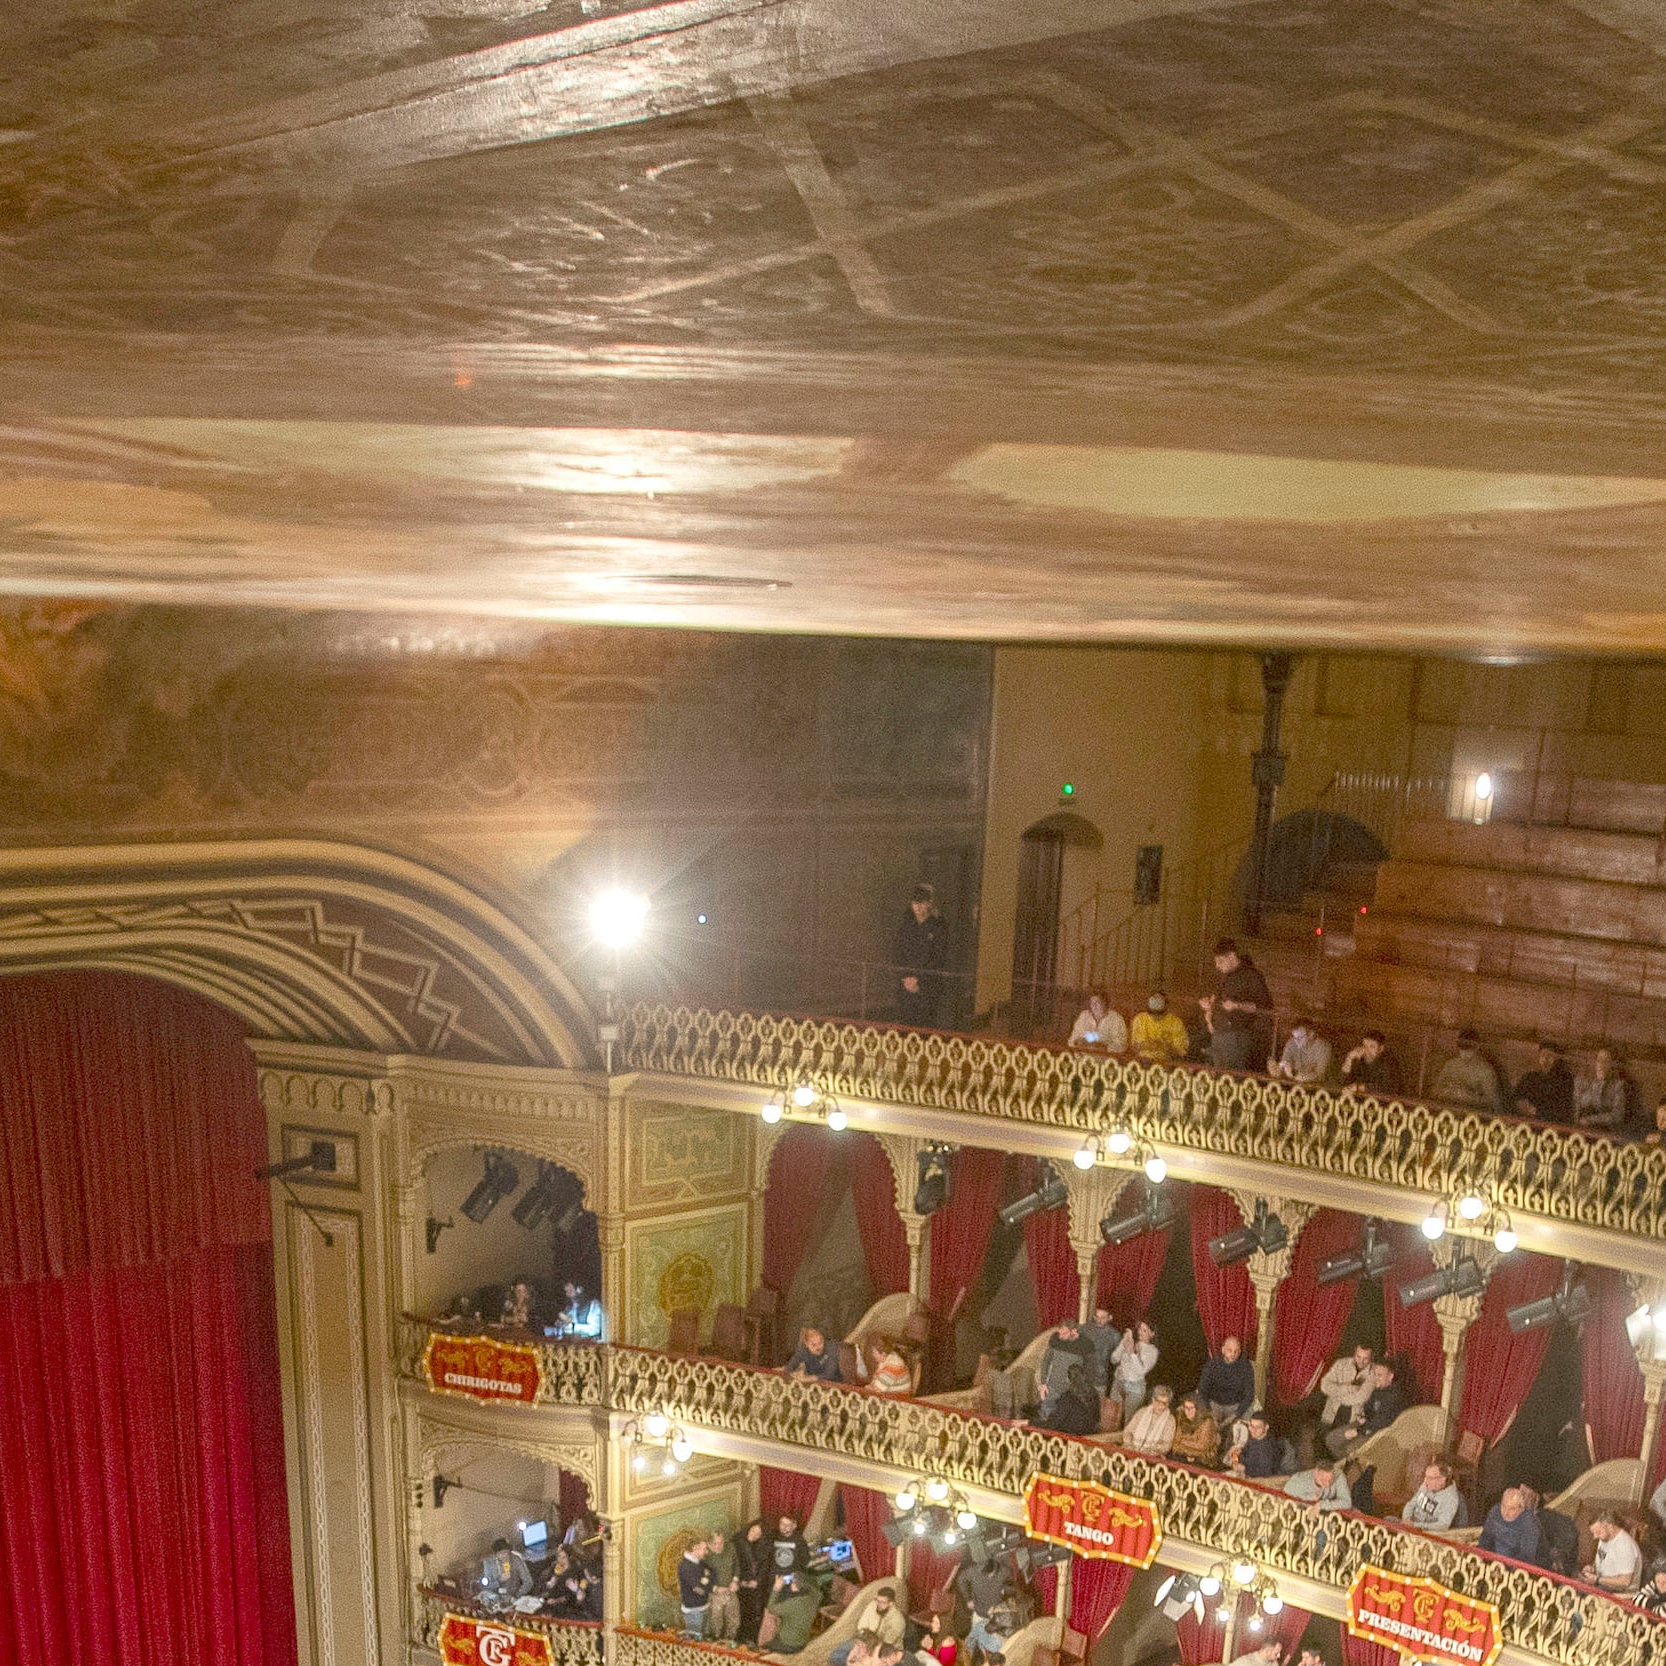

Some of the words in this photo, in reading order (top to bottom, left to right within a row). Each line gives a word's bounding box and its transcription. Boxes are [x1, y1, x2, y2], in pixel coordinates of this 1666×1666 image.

[444, 1372, 523, 1395] CHIRIGOTAS
[1064, 1521, 1114, 1546] TANGO
[1357, 1608, 1484, 1662] PRESENTACIÓN
